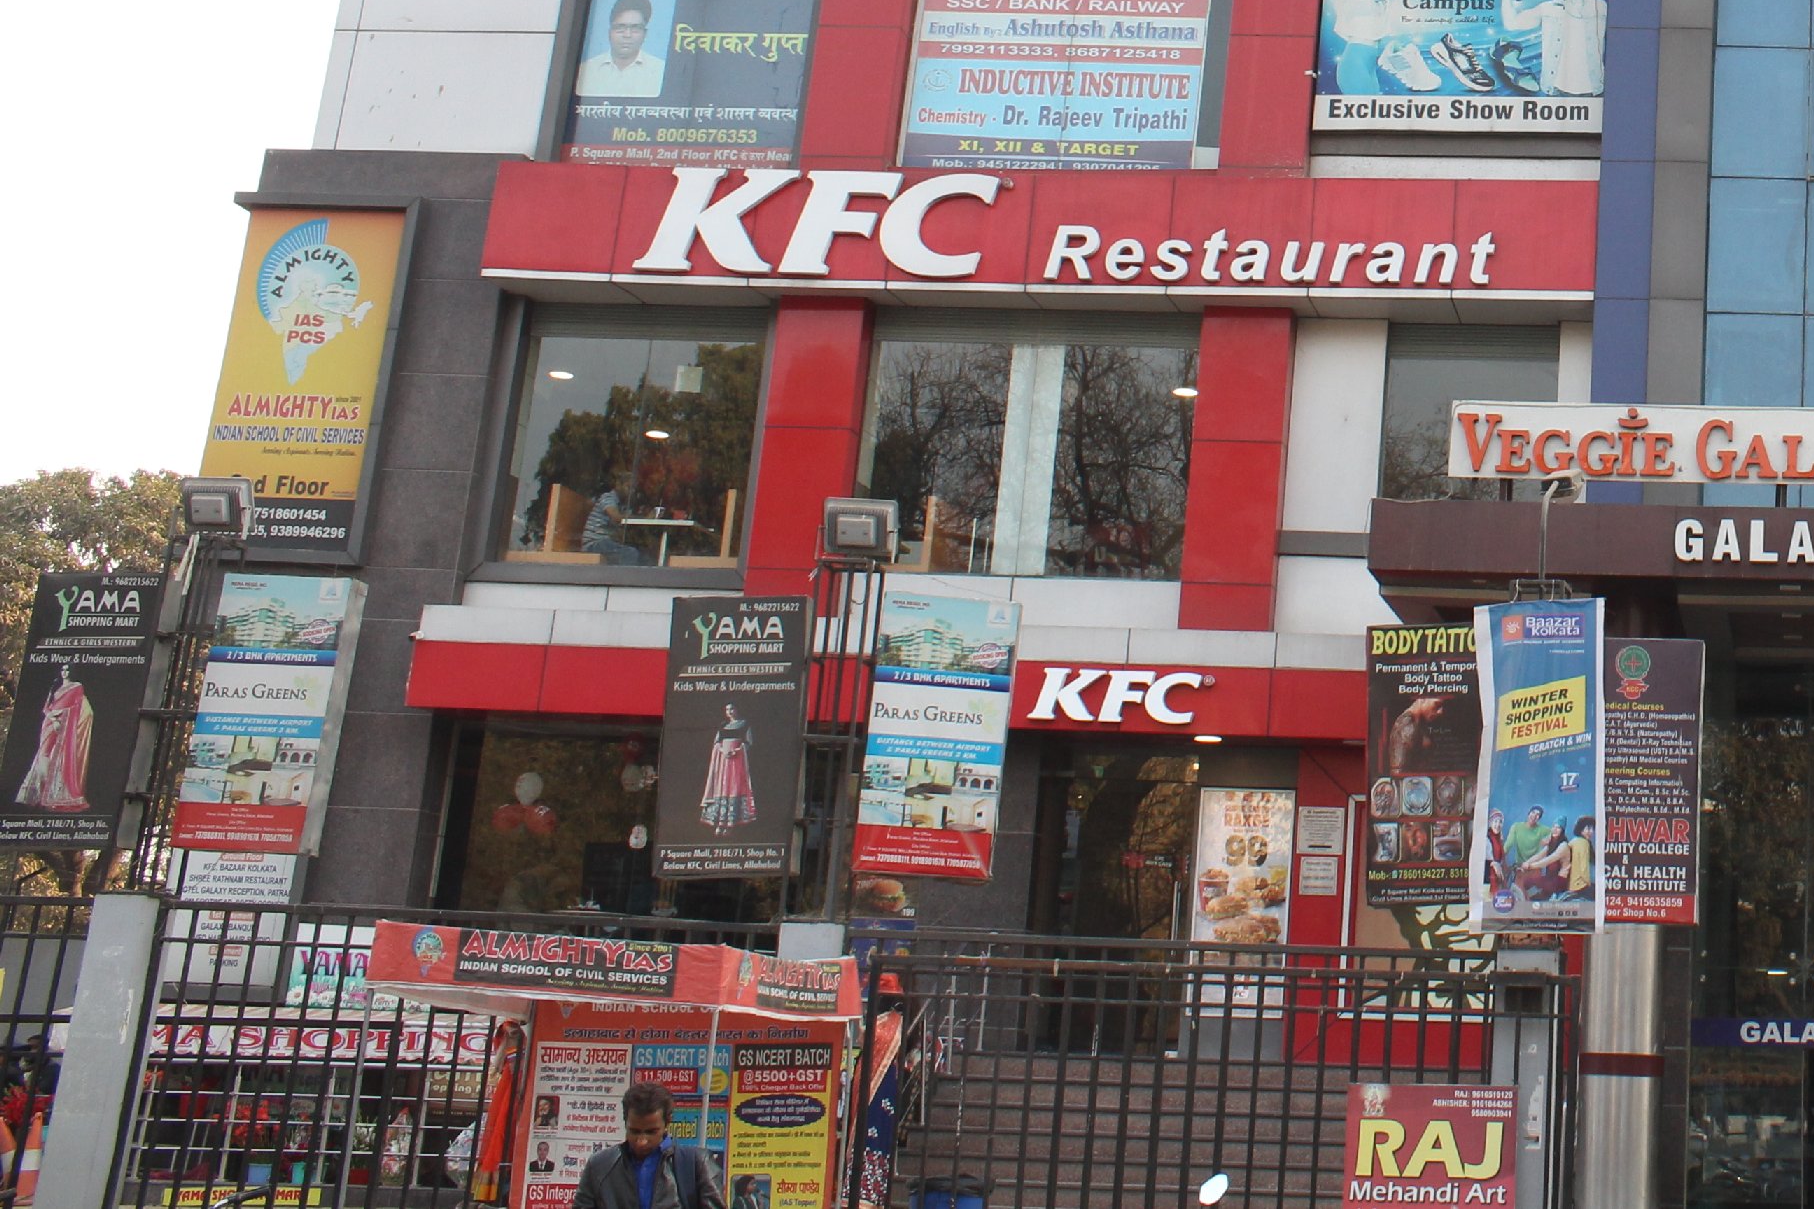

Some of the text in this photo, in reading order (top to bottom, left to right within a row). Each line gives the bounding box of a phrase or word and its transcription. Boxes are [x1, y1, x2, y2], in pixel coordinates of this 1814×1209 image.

[1089, 0, 1185, 14] RAILWAY
[929, 19, 1197, 40] English Ashutosh Asthana
[674, 24, 757, 57] दिवाकर
[1065, 46, 1181, 59] 8687125418
[959, 68, 1191, 100] INDUCTIVE INSTITUTE
[918, 105, 1187, 133] Chemistry Dr. Rajeev Tripathi
[1328, 99, 1589, 120] Exclusive Show Room
[612, 127, 757, 143] Mob. 8009676353
[1057, 142, 1139, 156] TARGET
[631, 167, 1495, 288] KFC Restaurant
[270, 248, 355, 299] ALMIGHTY
[293, 313, 325, 327] IAS
[287, 330, 326, 345] PCS
[228, 393, 359, 421] ALMIGHTY IAS
[213, 425, 365, 445] INDIAN SCHOOL SERVICES
[276, 475, 329, 495] Floor
[270, 524, 346, 539] 9389946296
[55, 586, 140, 632] YAMA
[692, 612, 783, 659] YAMA
[1372, 630, 1419, 654] BODY
[205, 682, 307, 700] PARAS GREENS
[1026, 667, 1202, 724] KFC
[1511, 689, 1568, 709] WINTER
[874, 702, 983, 725] PARAS GREENS
[1505, 701, 1573, 725] SHOPPING
[1511, 717, 1568, 739] FESTIVAL
[1529, 737, 1565, 754] SCRATCH
[1639, 844, 1689, 855] COLLEGE
[1634, 867, 1686, 879] HEALTH
[1628, 897, 1682, 907] 9415635859
[462, 929, 625, 968] ALMIGHTY
[622, 951, 672, 972] IAS
[608, 972, 668, 985] SERVICES
[541, 1045, 627, 1065] सामान्य अध्ययन
[636, 1048, 694, 1067] GS NCERT
[738, 1048, 830, 1066] GS NCERT BATCH
[743, 1070, 823, 1083] @5500+GST
[1355, 1119, 1504, 1181] RAJ
[1349, 1181, 1506, 1204] Mehandi Art
